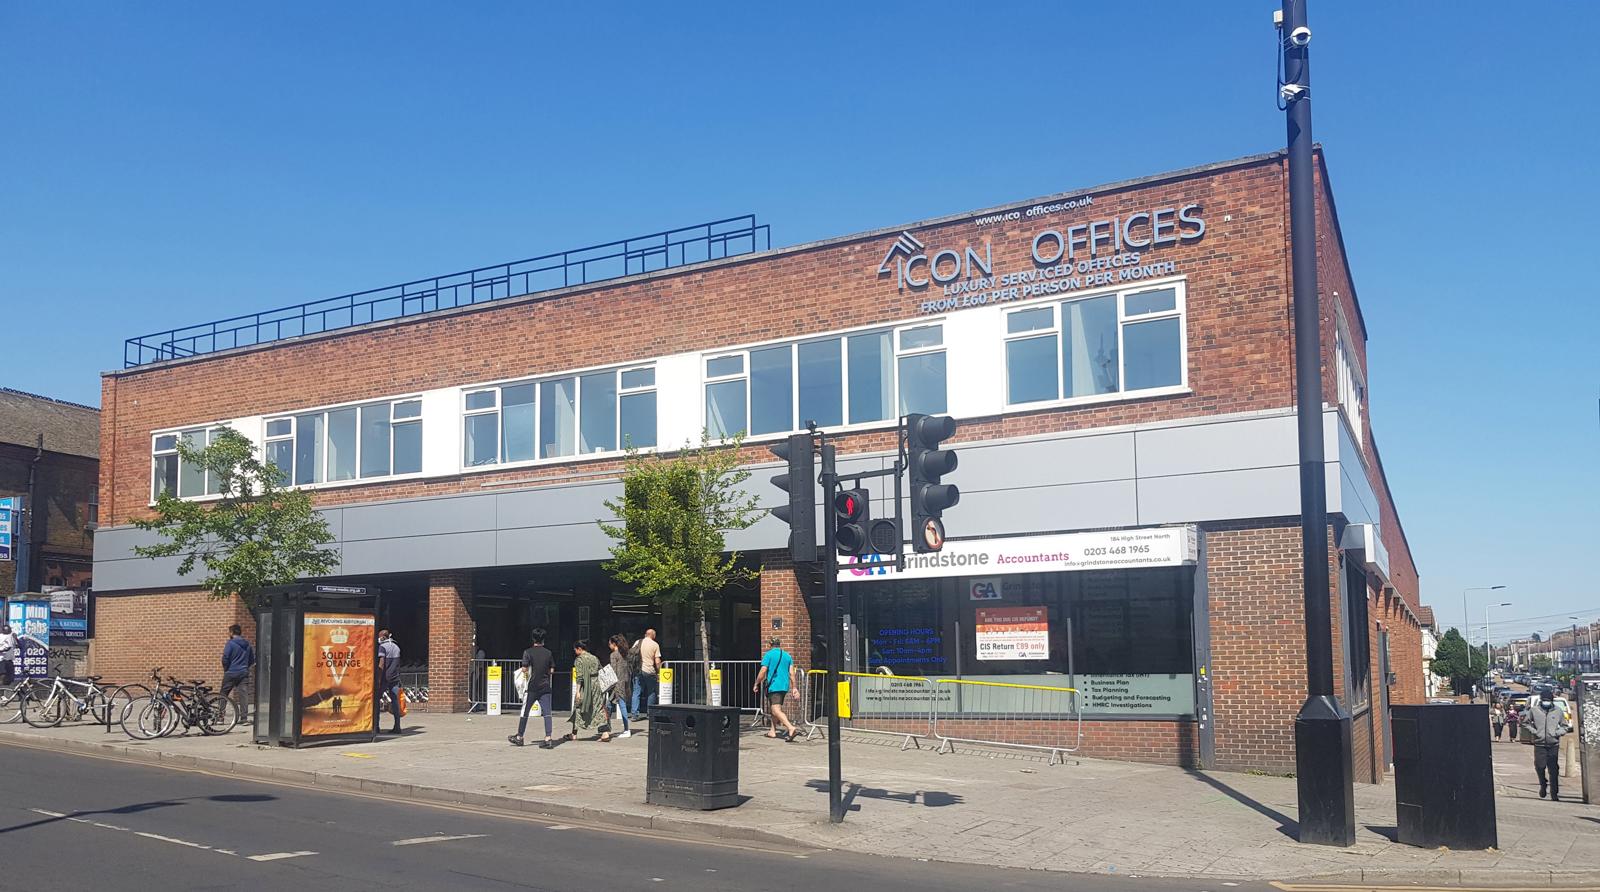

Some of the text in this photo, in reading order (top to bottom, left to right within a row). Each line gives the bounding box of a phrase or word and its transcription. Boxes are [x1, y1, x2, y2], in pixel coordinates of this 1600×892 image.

[1032, 204, 1206, 264] OFFICES
[944, 252, 1141, 296] LUXURY SERVICED OFFICES
[921, 260, 1175, 313] FROM £60 PER PERSON PER MONTH
[1084, 544, 1150, 556] 0203 468 1965
[902, 551, 1070, 570] rindstone Accountants
[26, 604, 48, 619] Mini
[25, 620, 48, 634] Cabs
[26, 648, 44, 656] 020
[980, 642, 991, 650] CIS
[1030, 642, 1045, 651] only
[322, 652, 356, 660] SOLDIER
